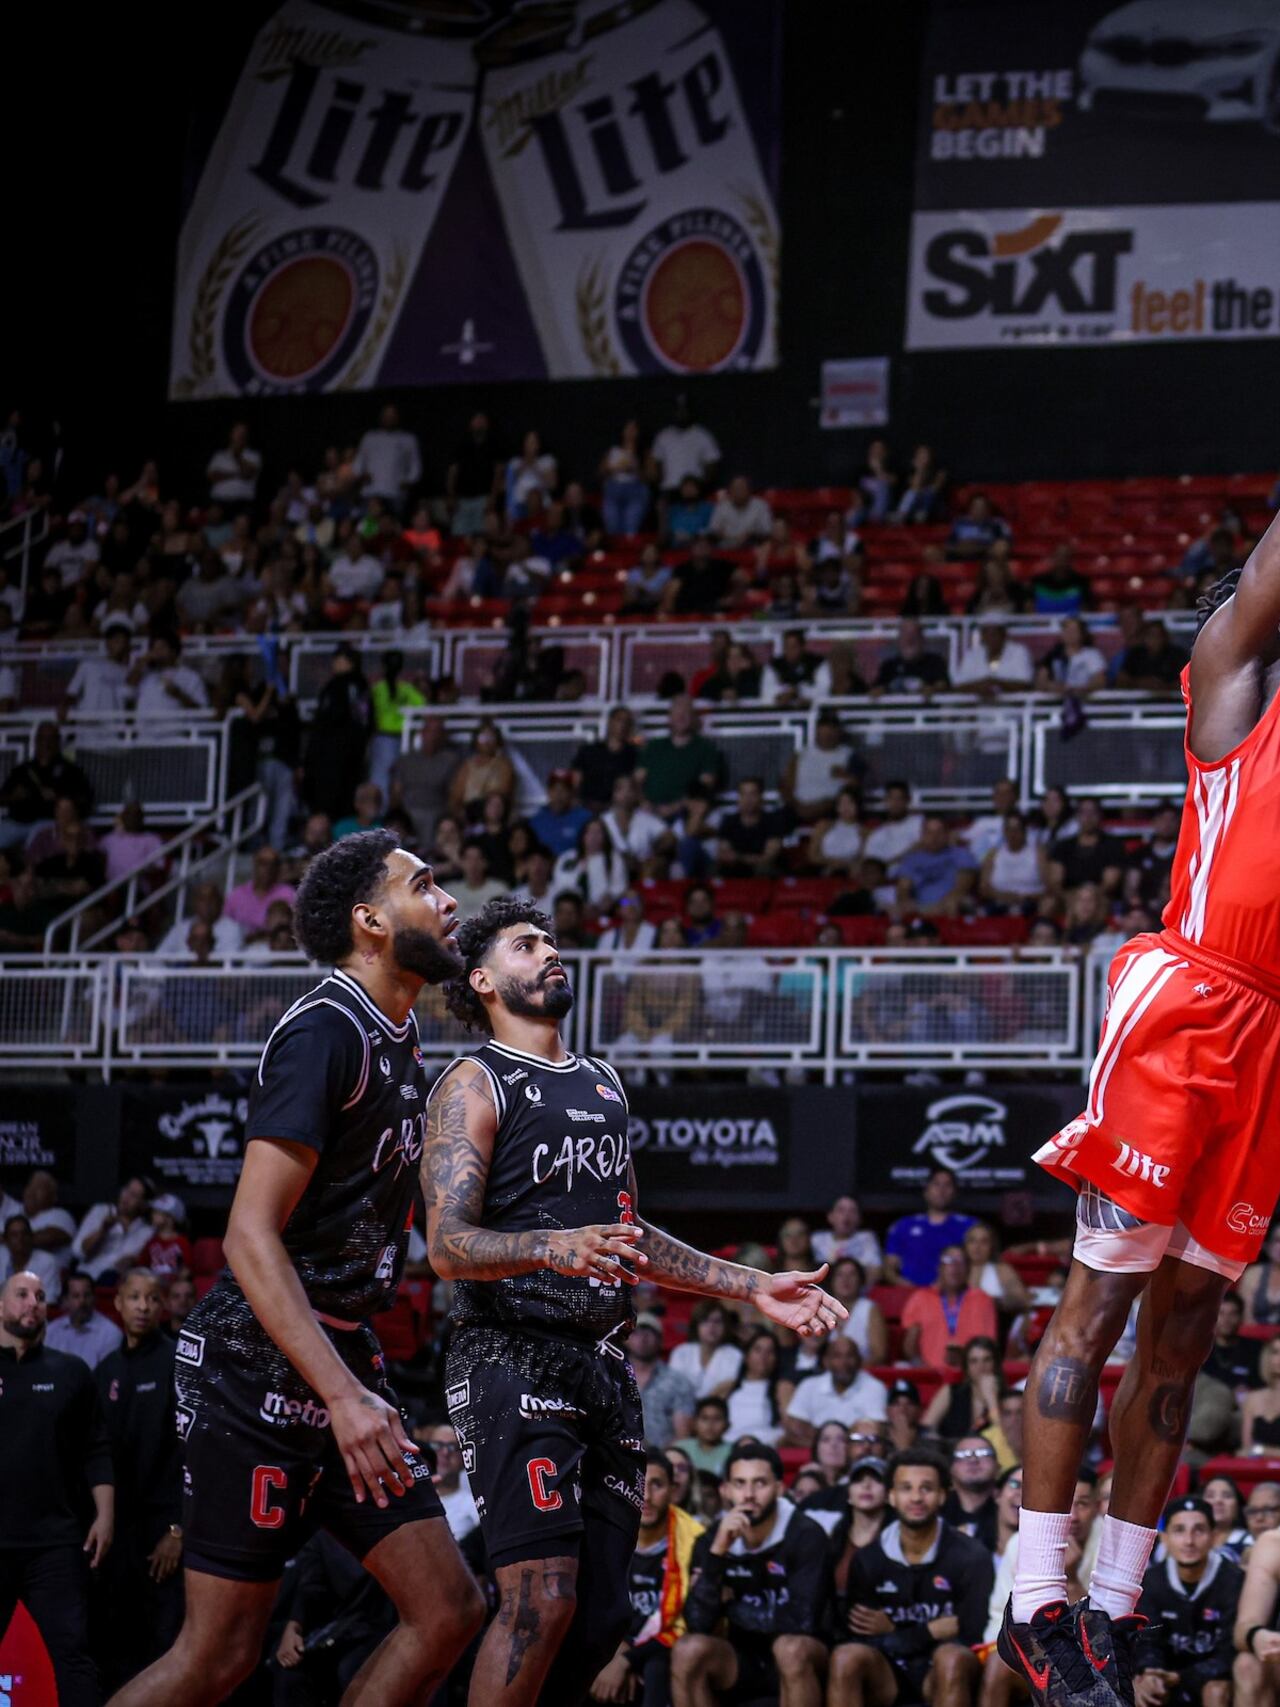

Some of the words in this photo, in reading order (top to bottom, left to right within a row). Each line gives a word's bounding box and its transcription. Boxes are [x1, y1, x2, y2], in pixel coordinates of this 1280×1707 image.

[933, 73, 998, 104] LET
[1004, 68, 1074, 101] THE
[248, 57, 467, 208] Lite
[528, 52, 731, 231] Lite
[930, 125, 1046, 160] BEGIN
[1131, 280, 1205, 332] feel
[1212, 279, 1272, 331] the
[651, 1118, 778, 1147] TOYOTA
[1110, 1140, 1171, 1188] Lite
[249, 1464, 287, 1529] C
[526, 1456, 563, 1513] C
